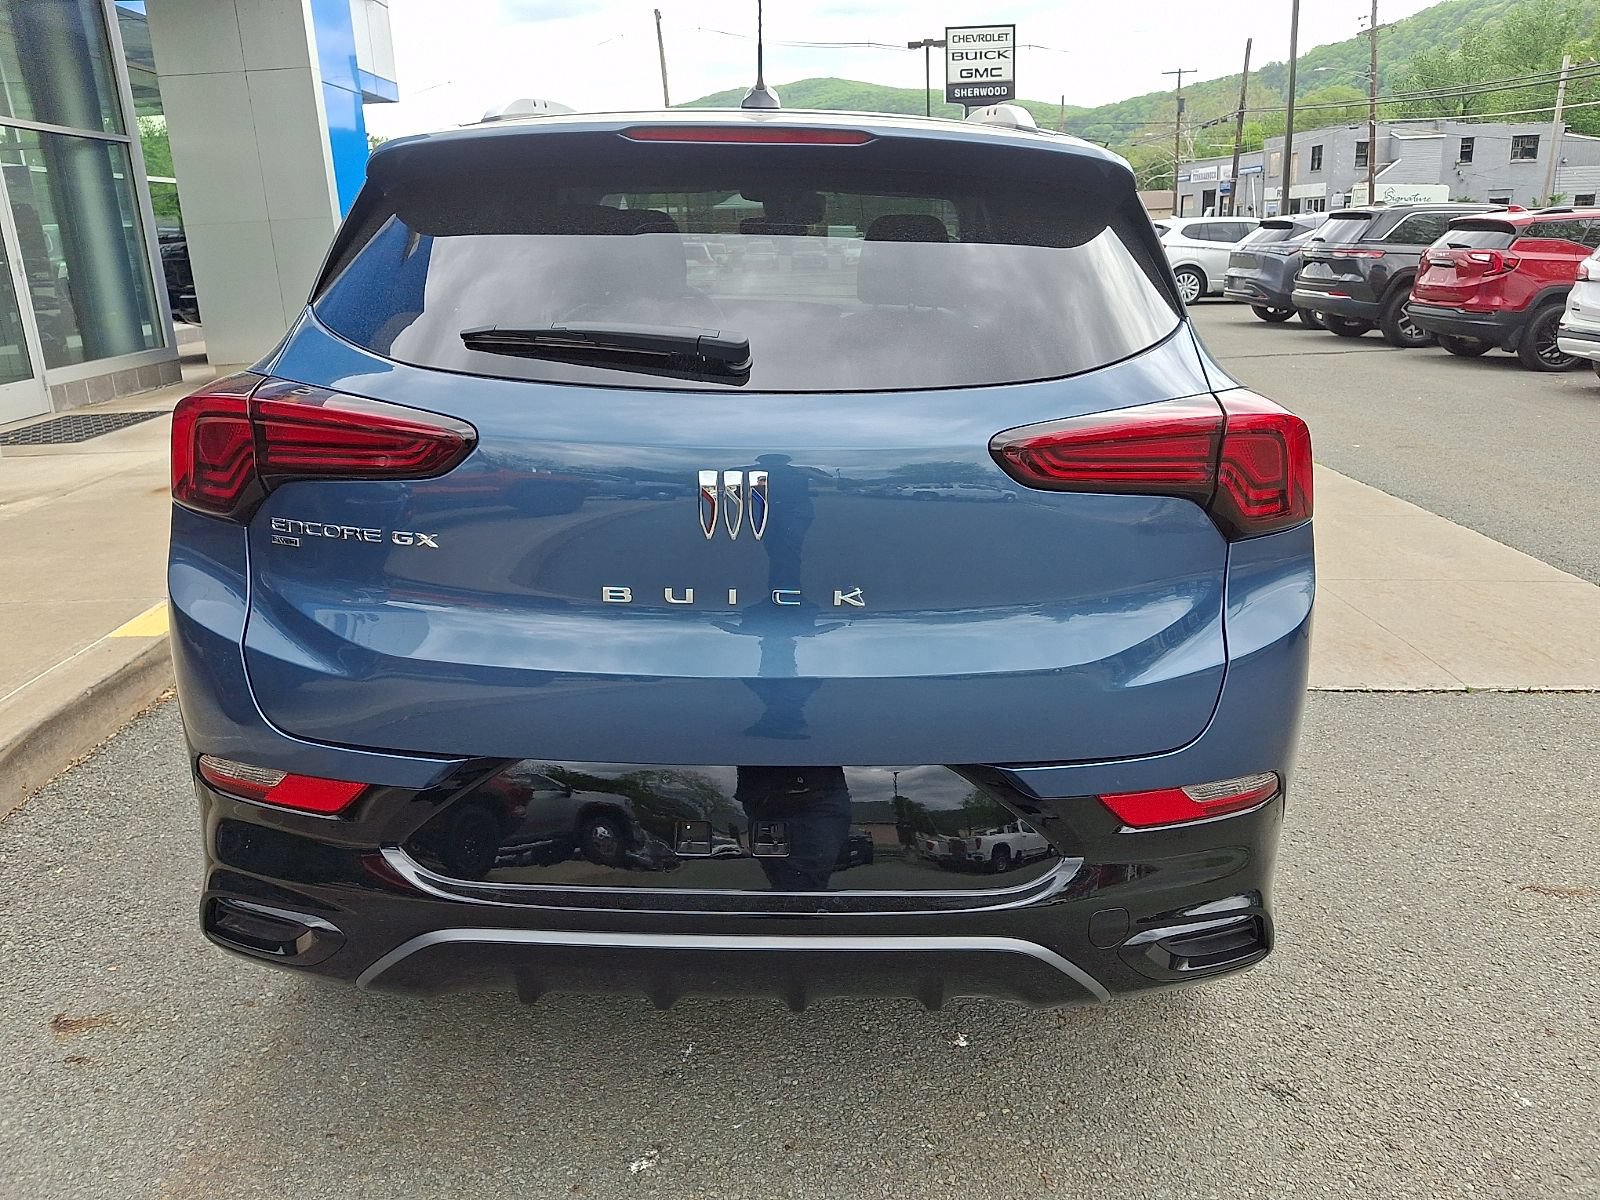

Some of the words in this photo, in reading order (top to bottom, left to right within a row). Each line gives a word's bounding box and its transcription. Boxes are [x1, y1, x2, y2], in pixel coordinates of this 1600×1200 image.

[952, 33, 1010, 44] CHEVROLET
[951, 49, 1011, 62] BUICK
[959, 67, 1003, 79] GMC
[954, 86, 1008, 98] SHERWOOD
[271, 517, 382, 544] ENCORE
[391, 530, 439, 549] GX
[602, 585, 867, 607] BUICK
